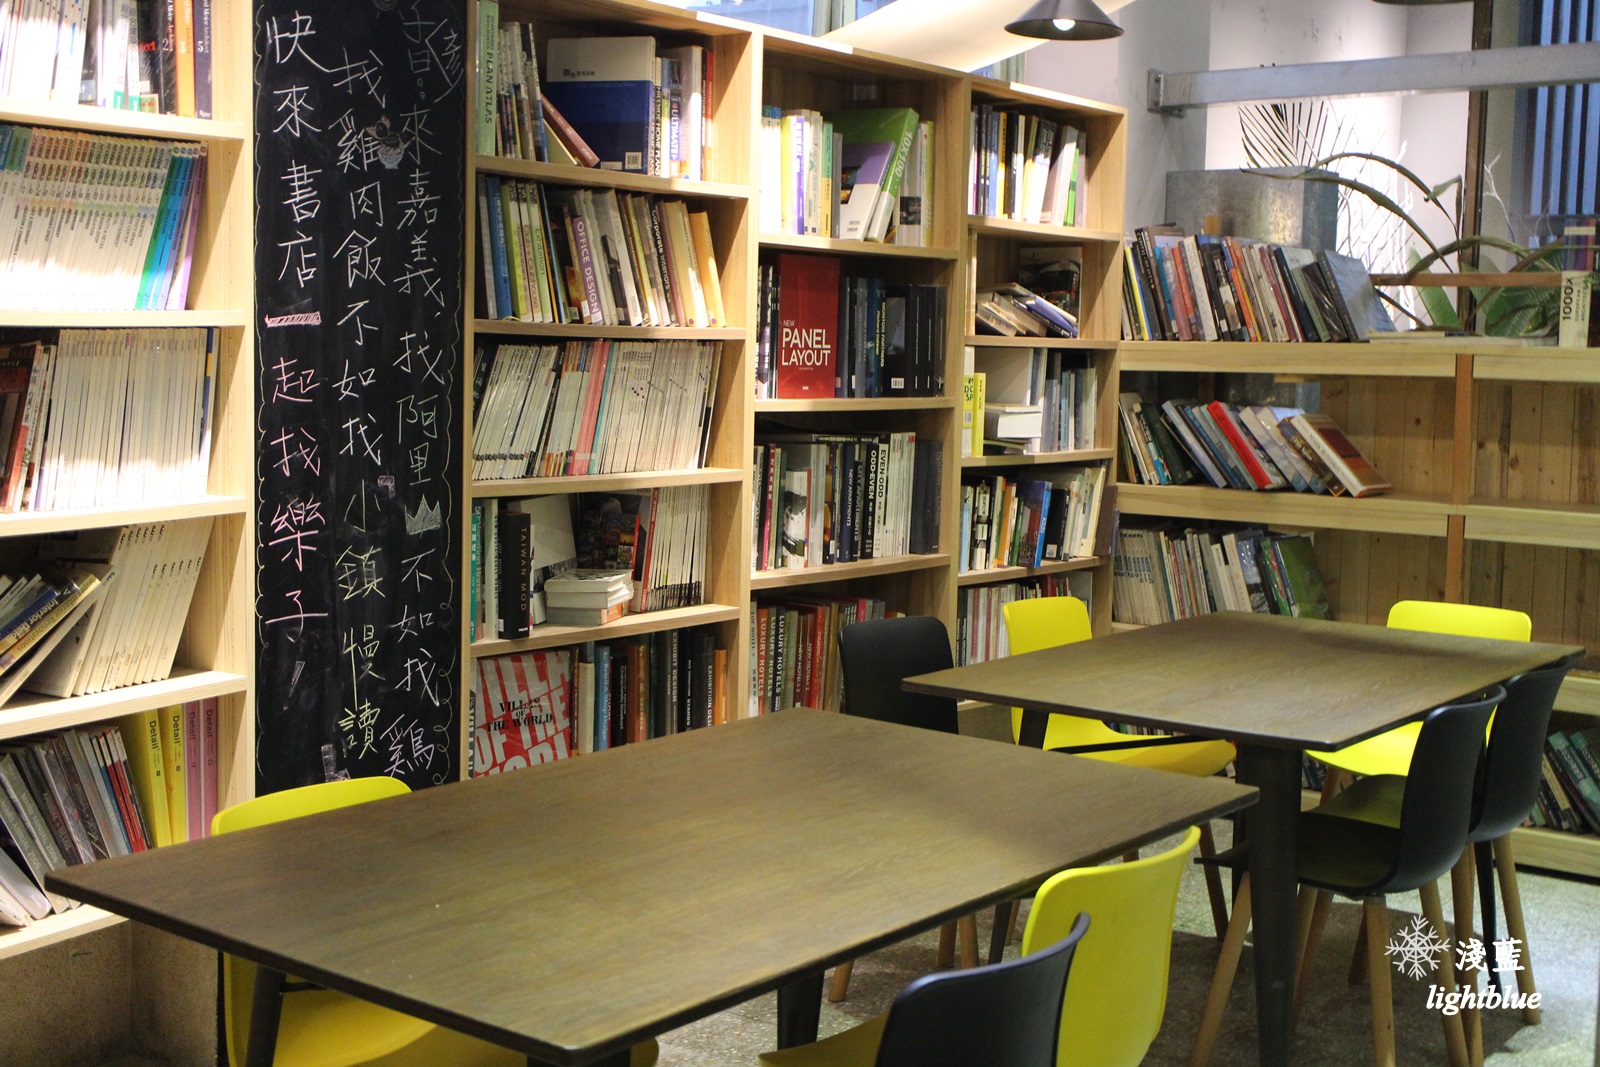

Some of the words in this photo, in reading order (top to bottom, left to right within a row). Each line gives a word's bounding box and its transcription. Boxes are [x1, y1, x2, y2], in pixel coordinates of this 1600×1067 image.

[162, 38, 168, 51] 2
[198, 41, 204, 53] 5
[486, 52, 494, 83] PLAN
[485, 86, 493, 124] ATLAS
[894, 131, 913, 177] 10X100
[523, 224, 533, 247] Club
[535, 228, 545, 275] Exhibition
[576, 221, 590, 264] OFFICE
[585, 265, 599, 313] DESIGN
[527, 257, 539, 309] Clubhouse
[783, 319, 796, 327] NEW
[782, 328, 831, 349] PANEL
[781, 349, 831, 366] LAYOUT
[27, 597, 60, 627] Interior
[53, 594, 80, 619] Interior
[14, 614, 58, 653] Renovations
[776, 657, 784, 693] HOTELS
[188, 711, 196, 740] Detail
[486, 719, 509, 732] THE
[513, 713, 553, 727] WORLD
[515, 710, 526, 718] OF
[149, 720, 159, 750] Detail
[172, 715, 181, 745] Detail
[12, 823, 29, 850] ANNUAL
[28, 850, 41, 870] 2006
[32, 816, 48, 844] ANNUAL
[46, 844, 59, 864] 2006
